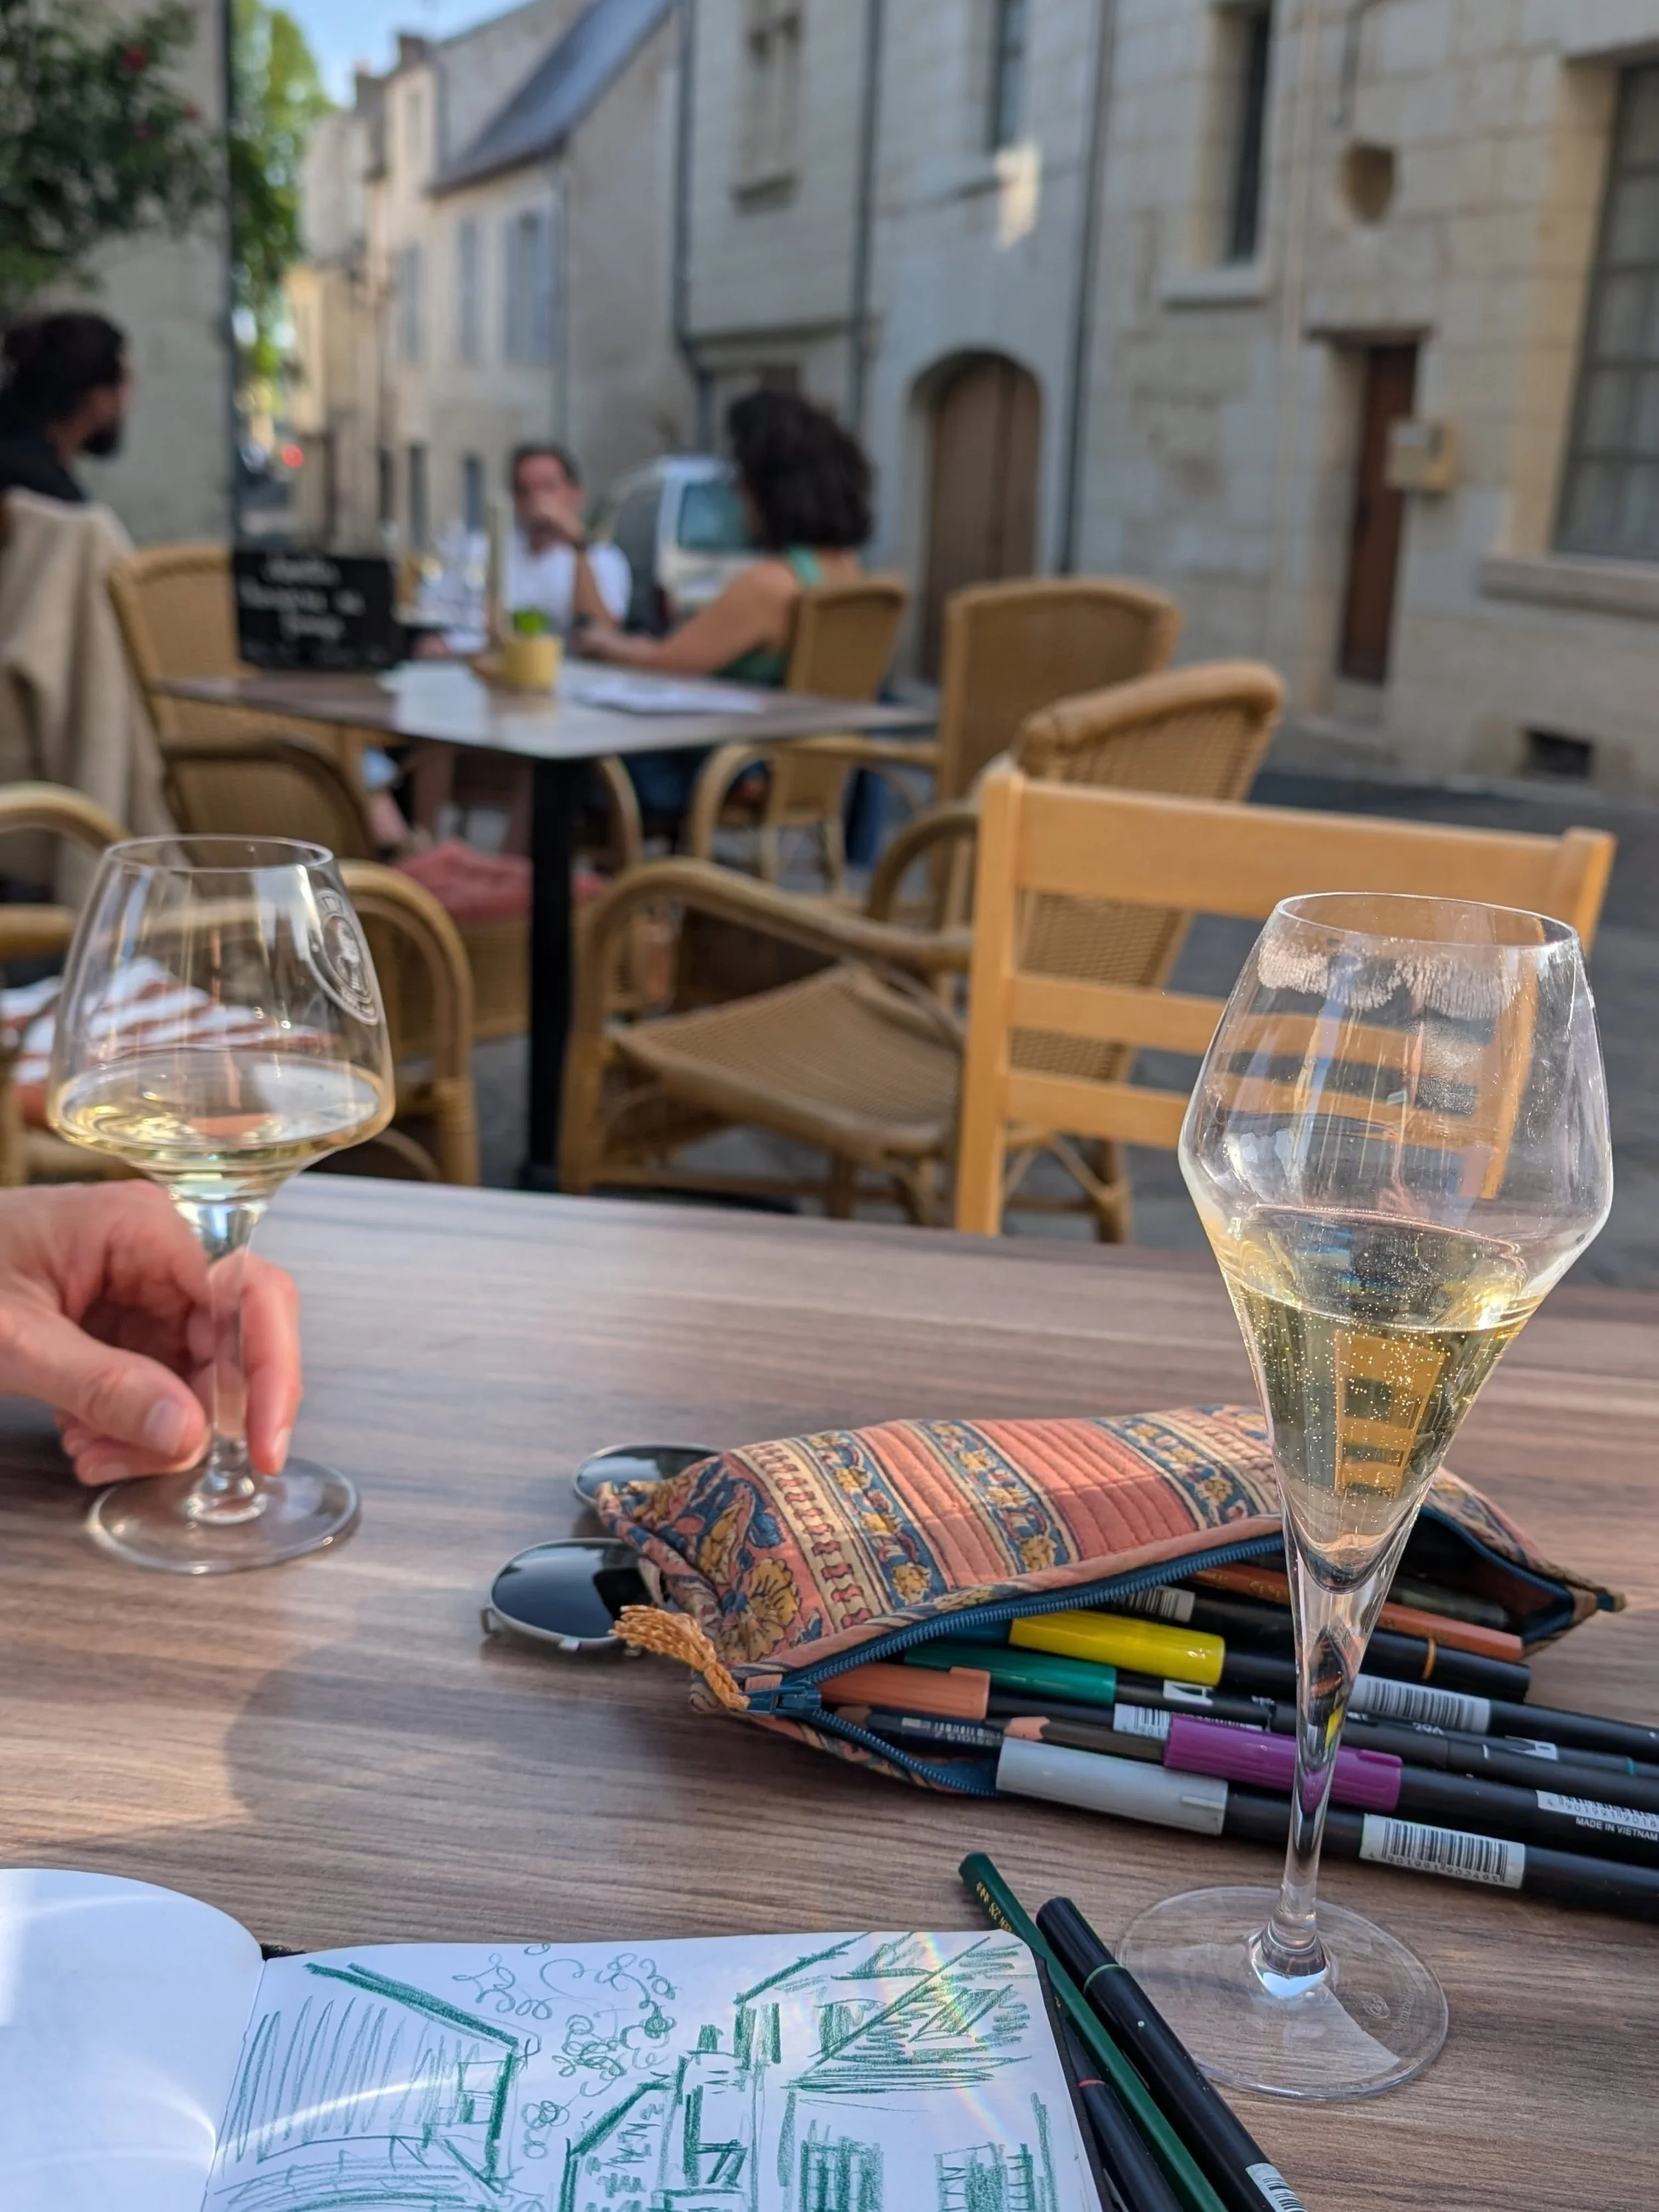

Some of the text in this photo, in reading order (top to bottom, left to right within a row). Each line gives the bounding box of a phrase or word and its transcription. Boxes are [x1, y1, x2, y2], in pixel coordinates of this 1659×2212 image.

[1547, 1798, 1553, 1806] 4
[1565, 1802, 1615, 1818] 901991
[1575, 1816, 1658, 1841] MADE IN VIETNAM
